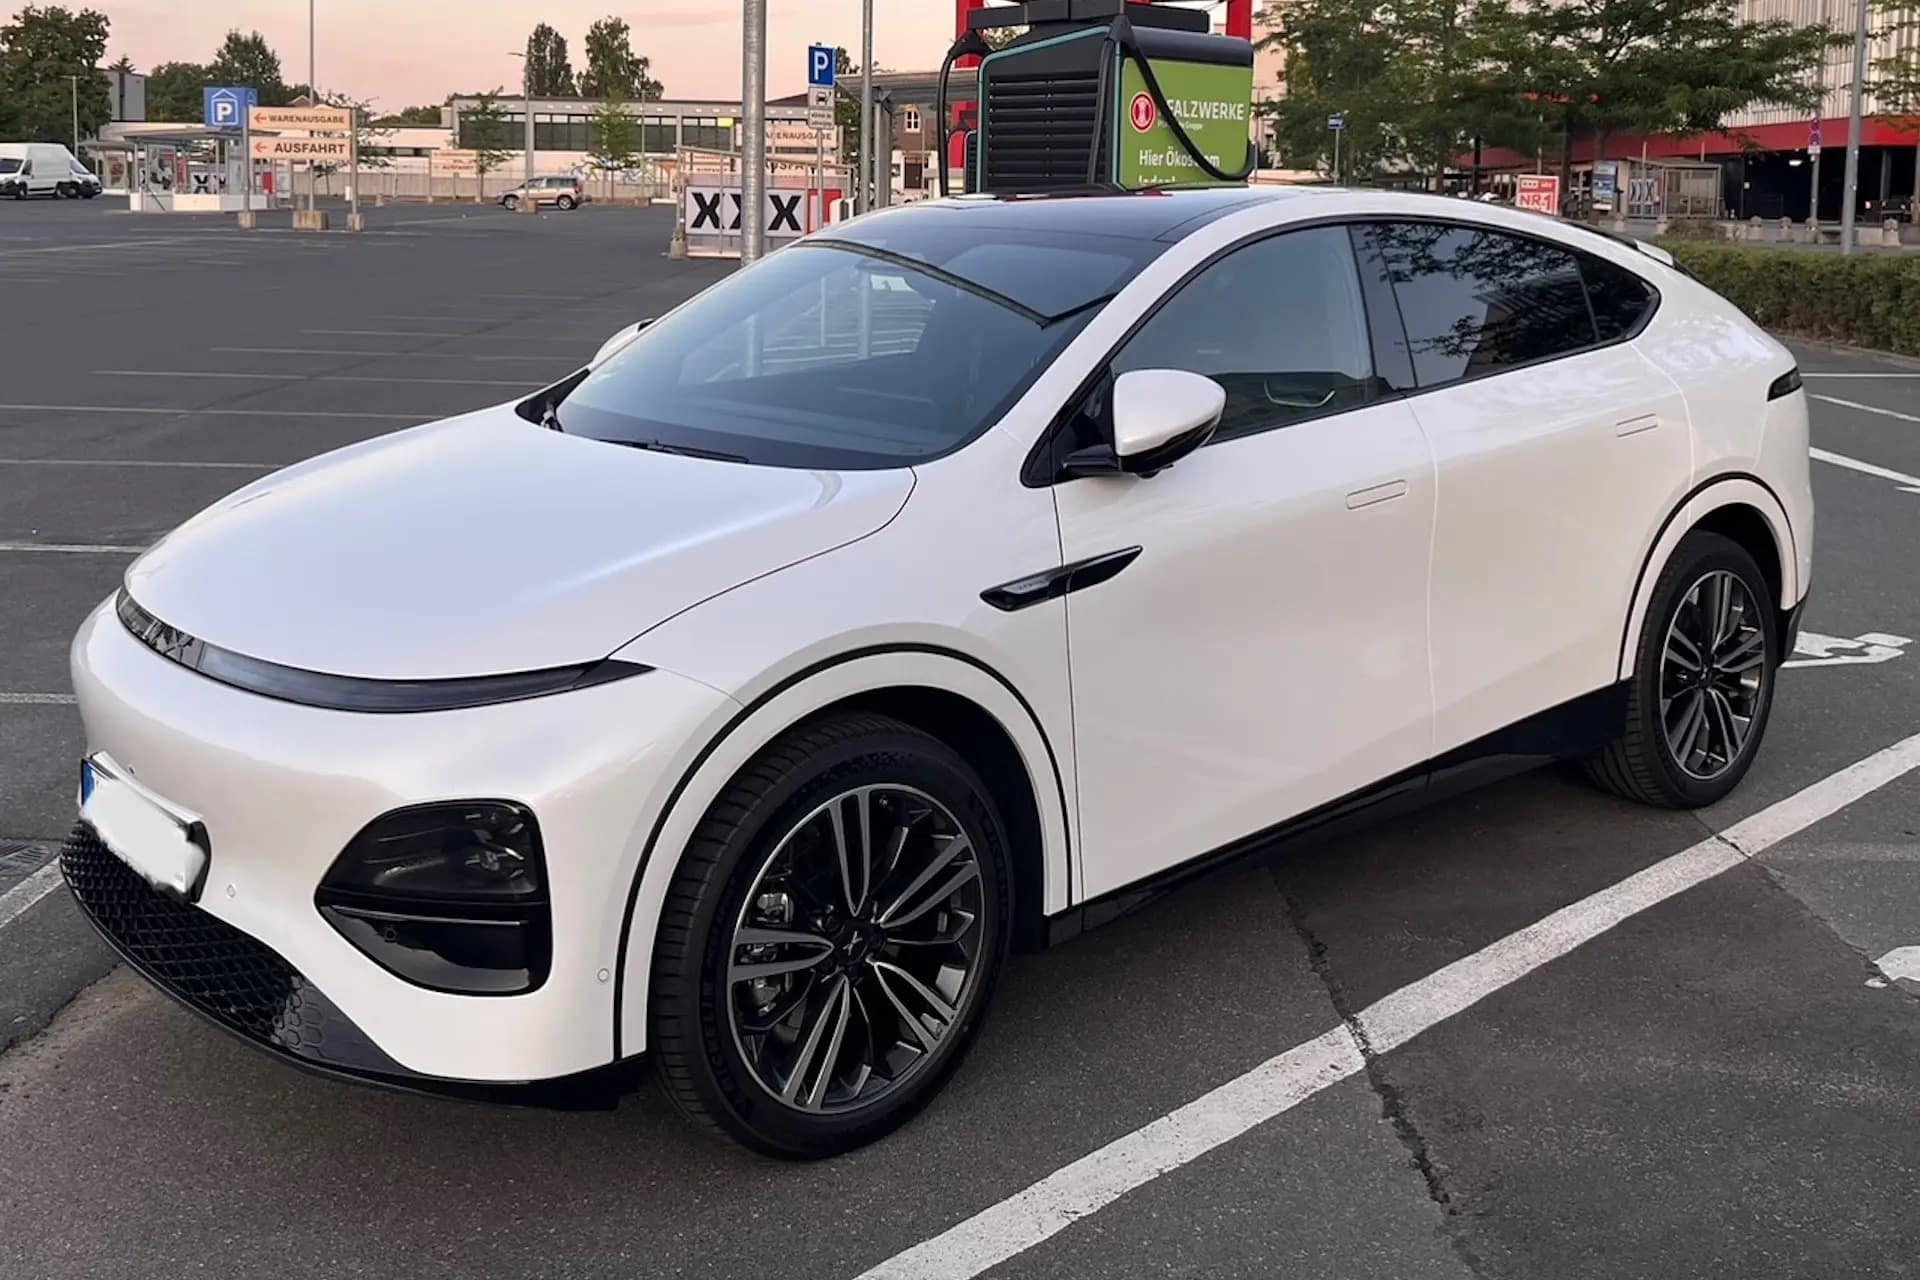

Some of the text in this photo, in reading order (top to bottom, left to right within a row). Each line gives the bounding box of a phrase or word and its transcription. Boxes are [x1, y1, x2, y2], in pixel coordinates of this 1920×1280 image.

[814, 50, 829, 80] P
[216, 102, 233, 121] P
[268, 114, 345, 123] WARENAUSGABE
[1158, 99, 1244, 120] FALZWERKE
[274, 143, 345, 154] AUSFAHRT
[1139, 149, 1163, 166] Hier
